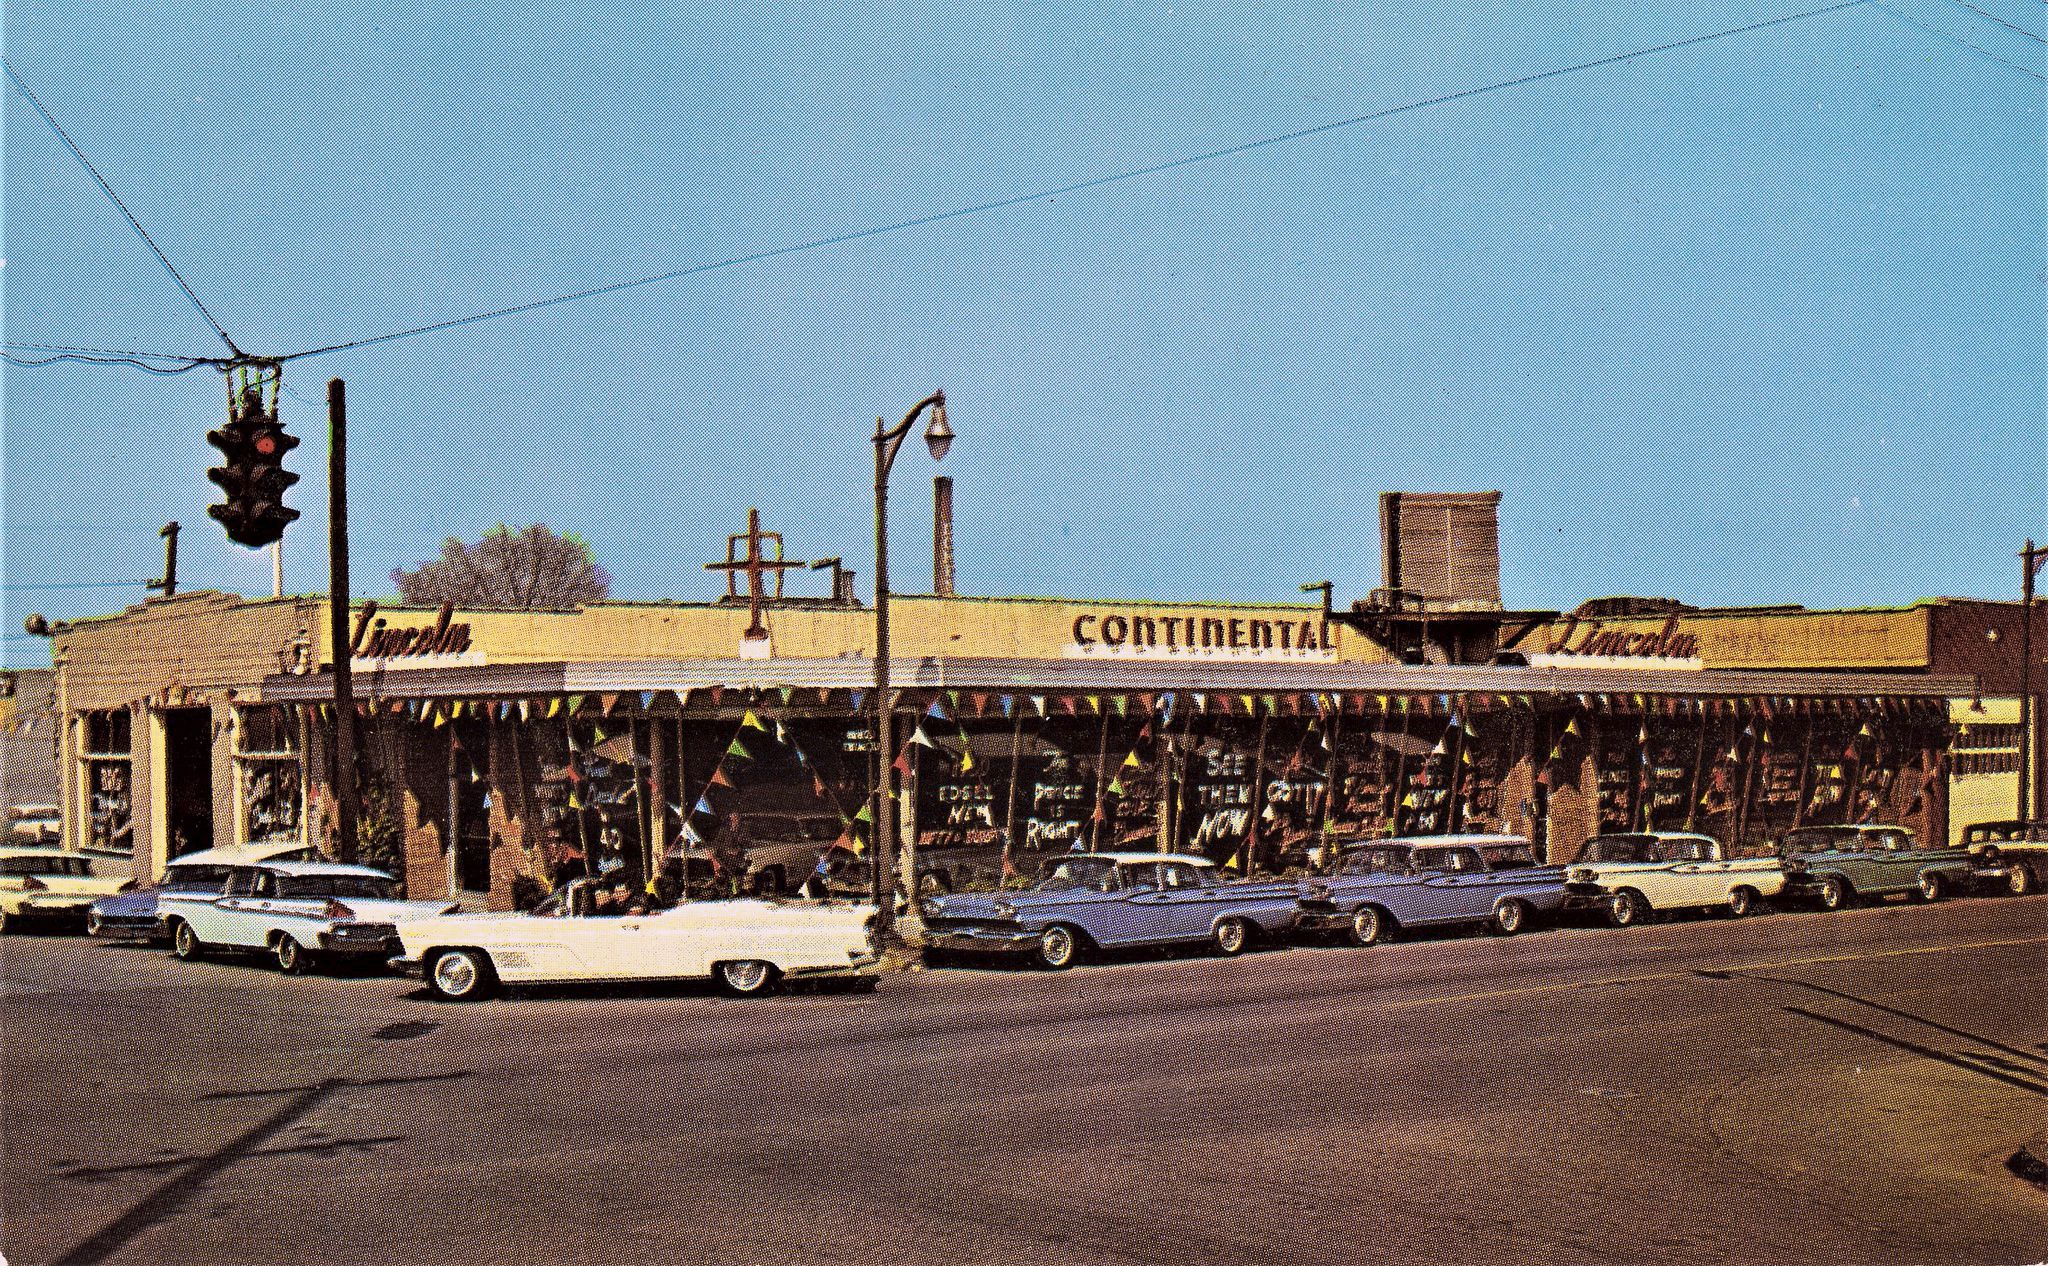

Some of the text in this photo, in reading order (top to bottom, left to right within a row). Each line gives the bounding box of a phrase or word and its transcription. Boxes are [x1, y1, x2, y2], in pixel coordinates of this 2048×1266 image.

[350, 601, 473, 659] Lincoln
[1072, 613, 1337, 650] CONTINENTAL
[1544, 612, 1699, 660] Lincoln
